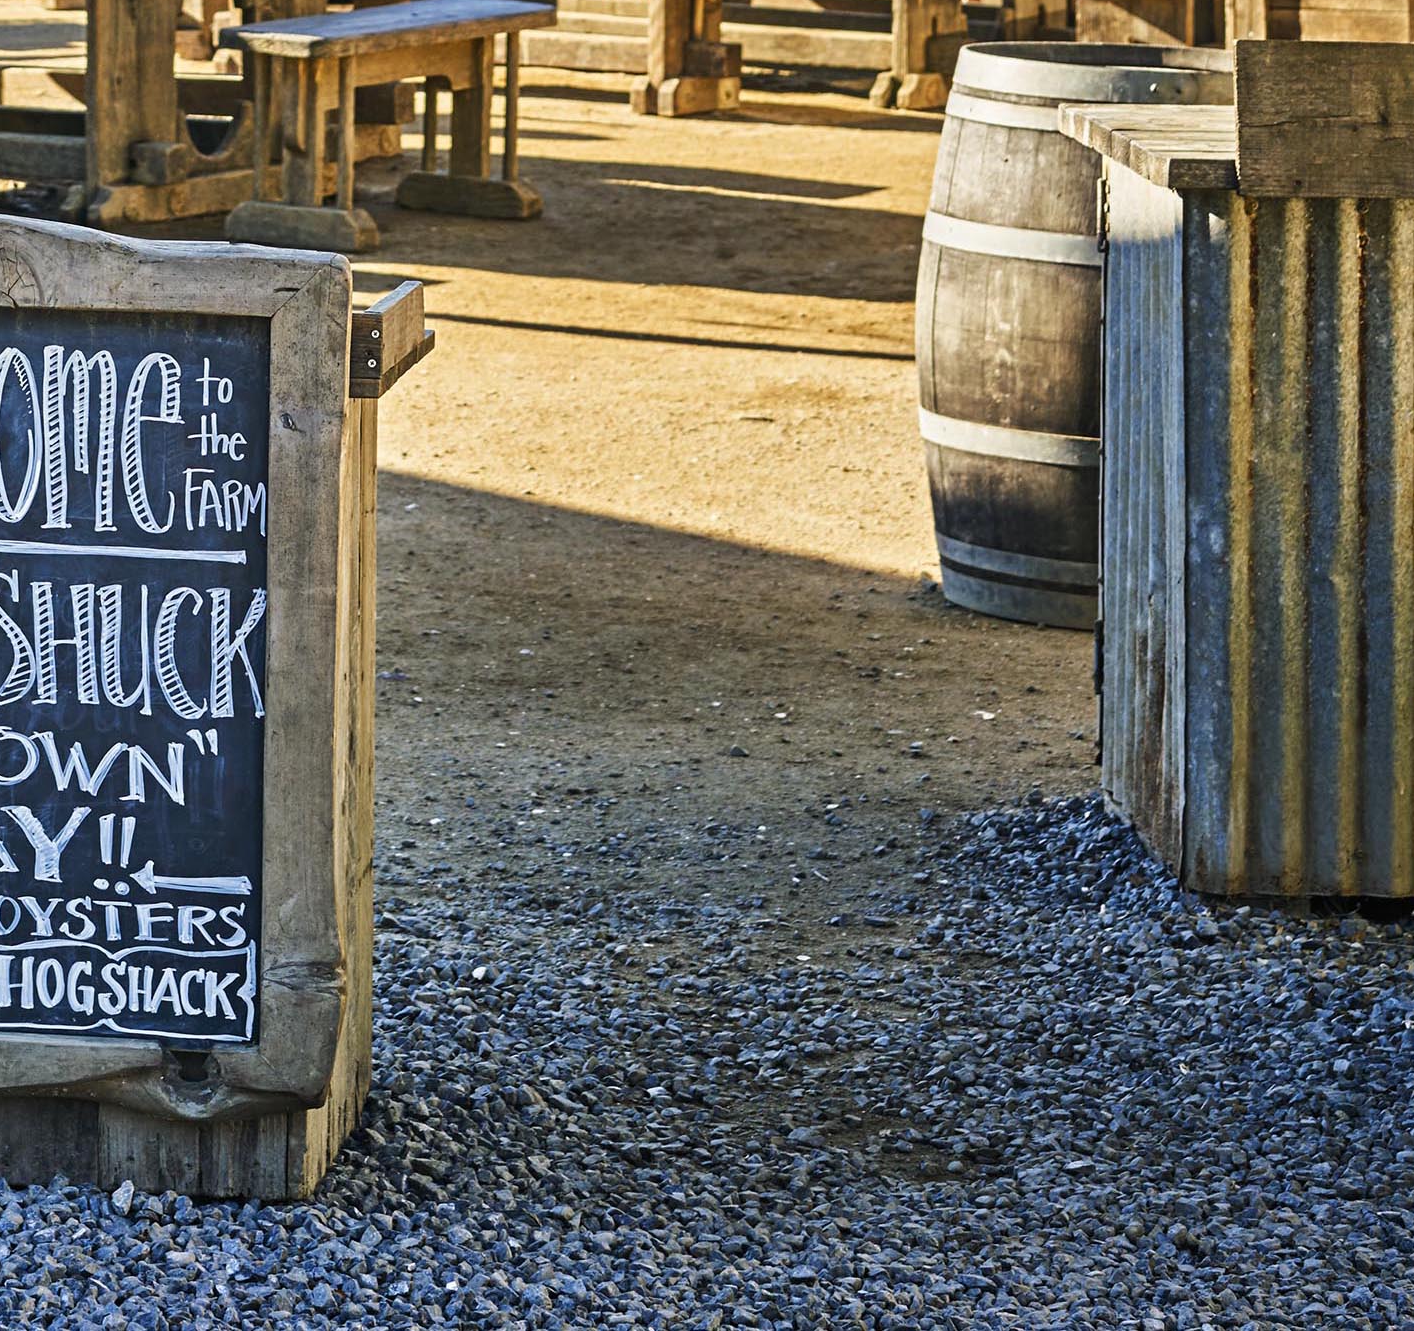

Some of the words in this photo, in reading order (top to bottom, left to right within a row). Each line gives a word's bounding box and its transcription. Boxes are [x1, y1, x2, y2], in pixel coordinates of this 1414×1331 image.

[195, 357, 234, 406] to
[187, 412, 248, 462] the
[182, 467, 267, 538] FARM
